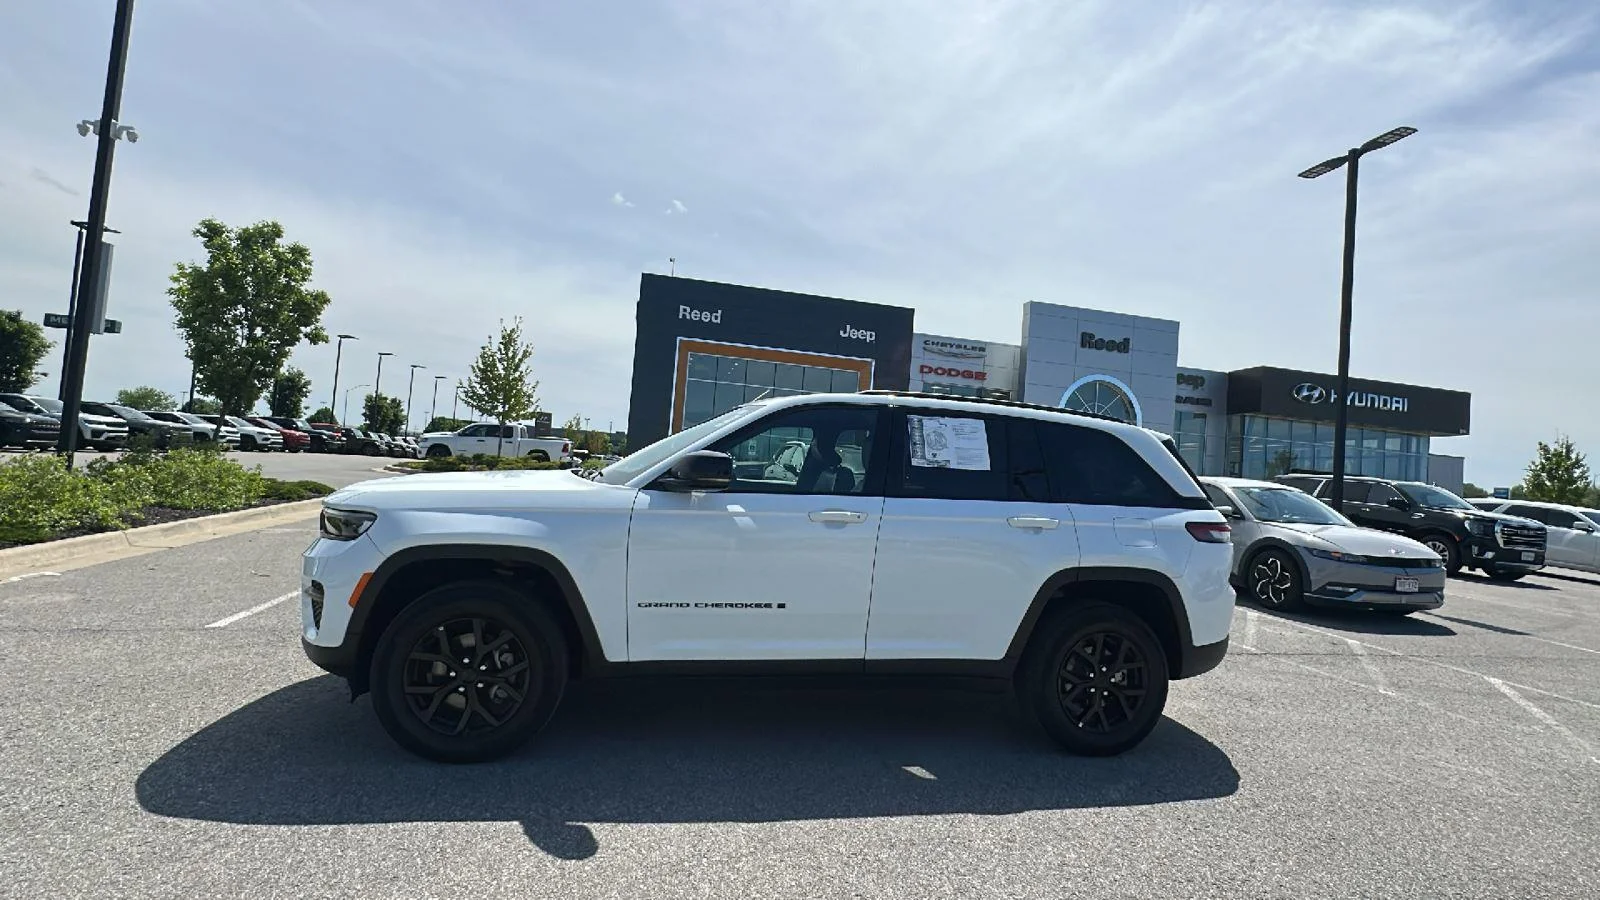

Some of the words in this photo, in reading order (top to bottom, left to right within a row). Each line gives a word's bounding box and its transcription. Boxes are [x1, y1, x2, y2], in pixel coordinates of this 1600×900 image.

[678, 304, 722, 324] Reed
[839, 324, 876, 343] Jeep
[1080, 331, 1130, 353] Reed
[923, 339, 986, 353] CHRYSLER
[919, 364, 987, 381] DODGE
